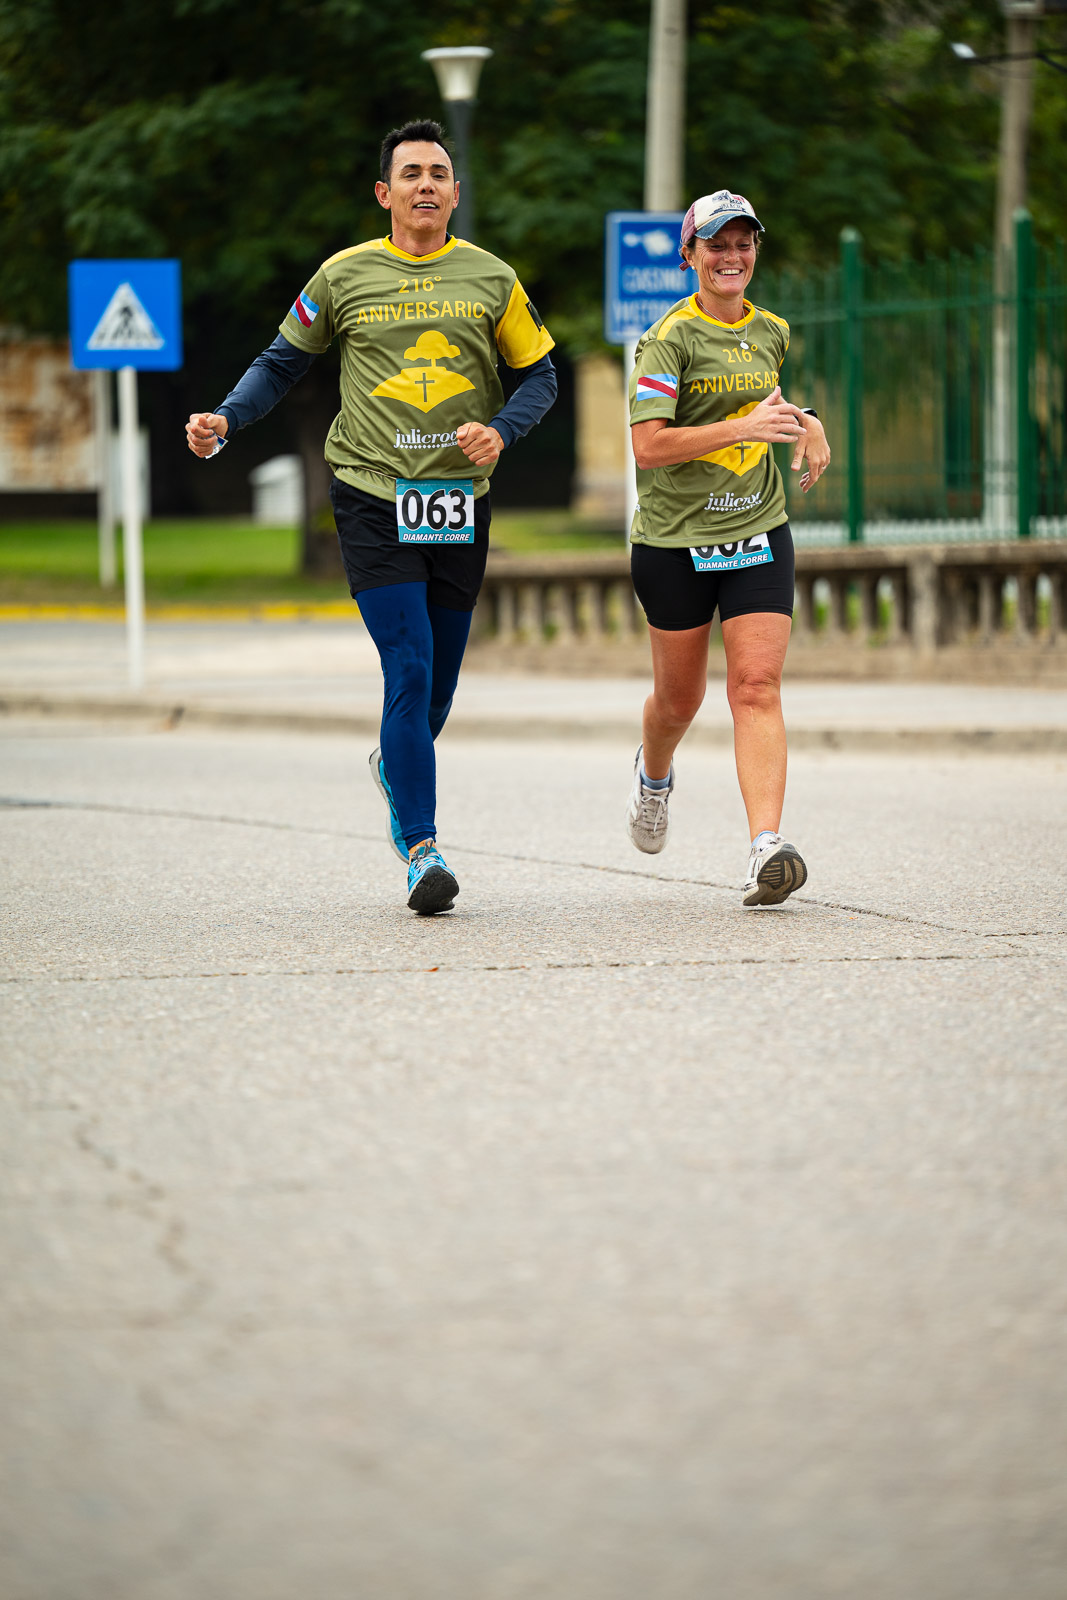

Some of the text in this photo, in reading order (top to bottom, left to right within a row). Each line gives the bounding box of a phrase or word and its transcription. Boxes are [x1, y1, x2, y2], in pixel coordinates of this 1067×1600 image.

[398, 275, 442, 294] 216°
[356, 300, 486, 325] ANIVERSARIO
[722, 344, 758, 363] 216°
[401, 488, 467, 531] 063
[402, 533, 471, 542] DIAMANTE CORRE
[698, 553, 769, 570] DIAMANTE CORRE
